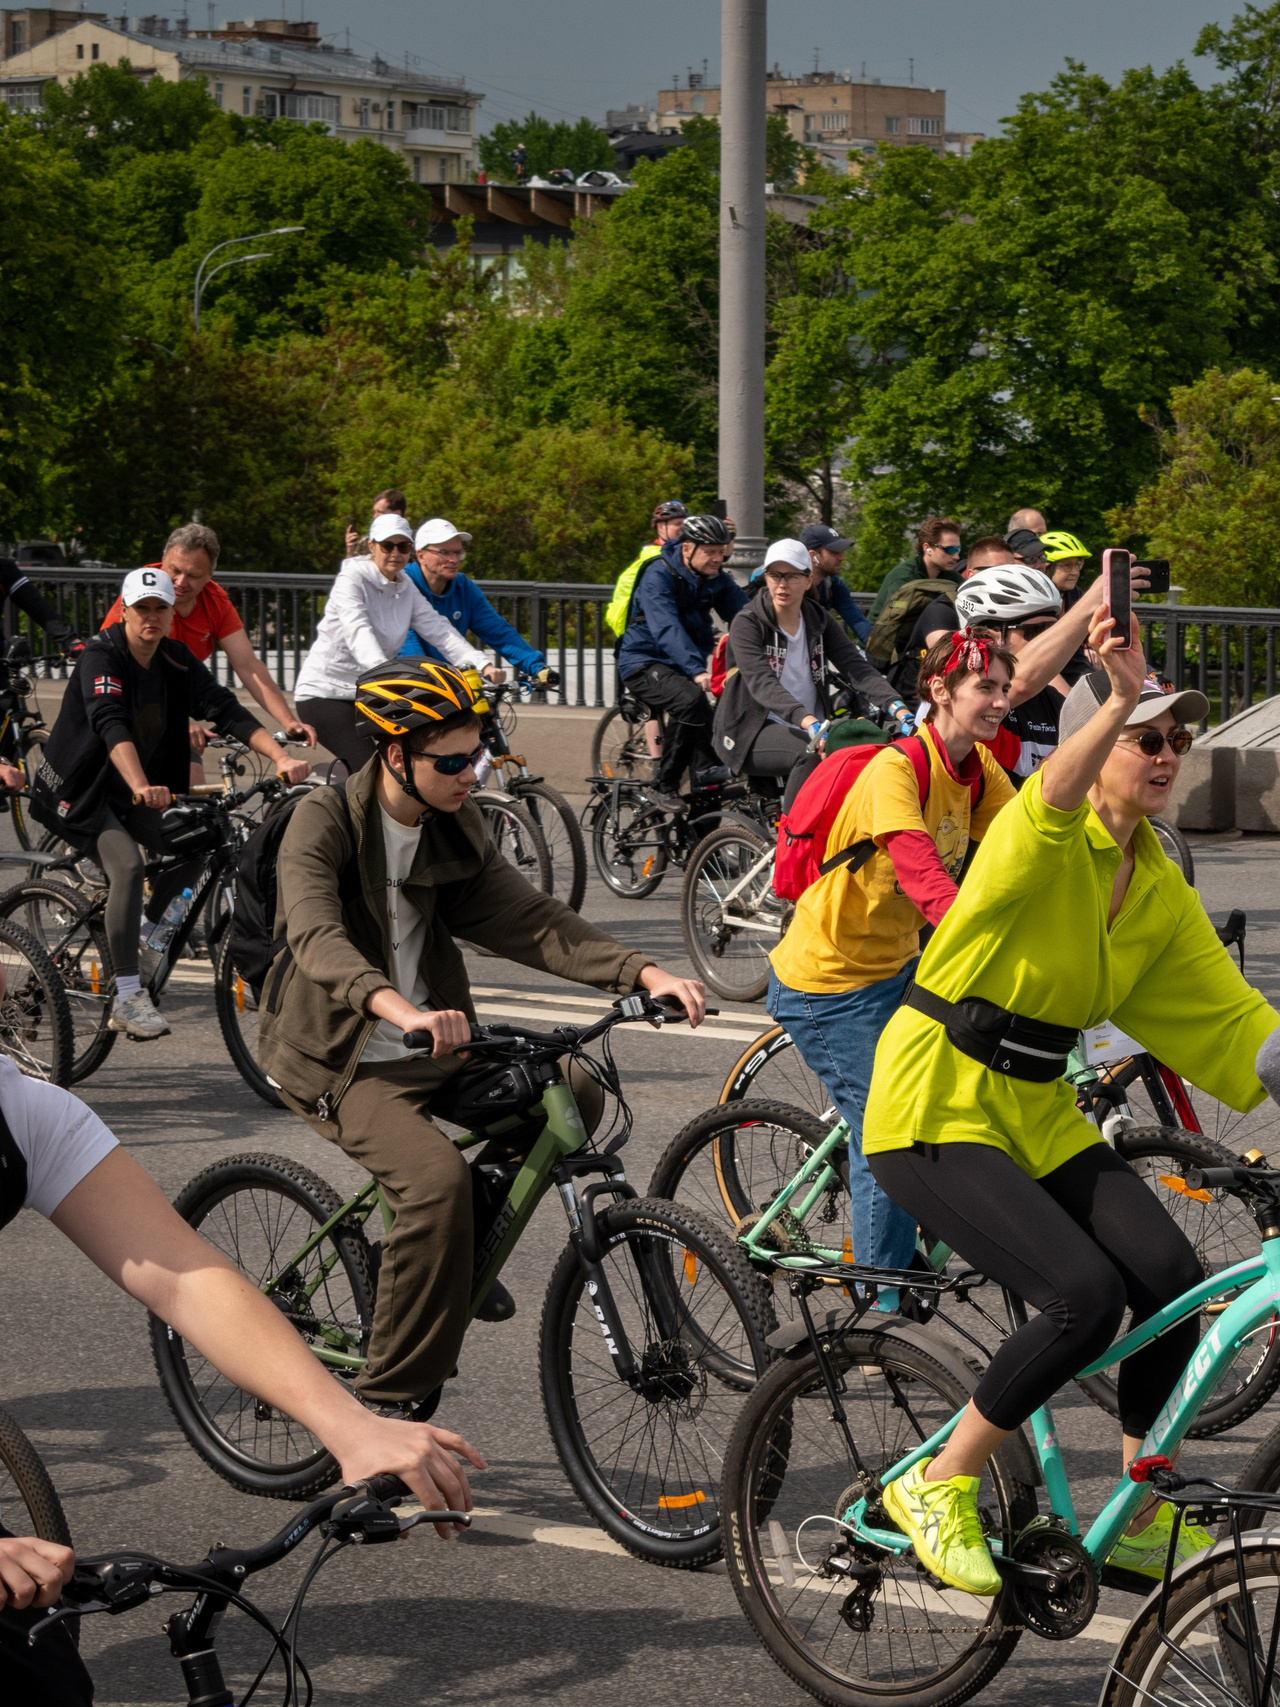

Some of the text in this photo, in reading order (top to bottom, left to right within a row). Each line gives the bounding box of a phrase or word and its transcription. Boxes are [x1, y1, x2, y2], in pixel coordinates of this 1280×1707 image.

[142, 572, 157, 586] C
[962, 599, 975, 612] 3512
[636, 1217, 679, 1236] KENDA
[609, 1232, 627, 1244] MTB
[1141, 1321, 1222, 1458] ASPECT
[283, 1518, 311, 1548] STELS
[693, 1524, 711, 1536] MTB
[730, 1510, 752, 1587] KENDA
